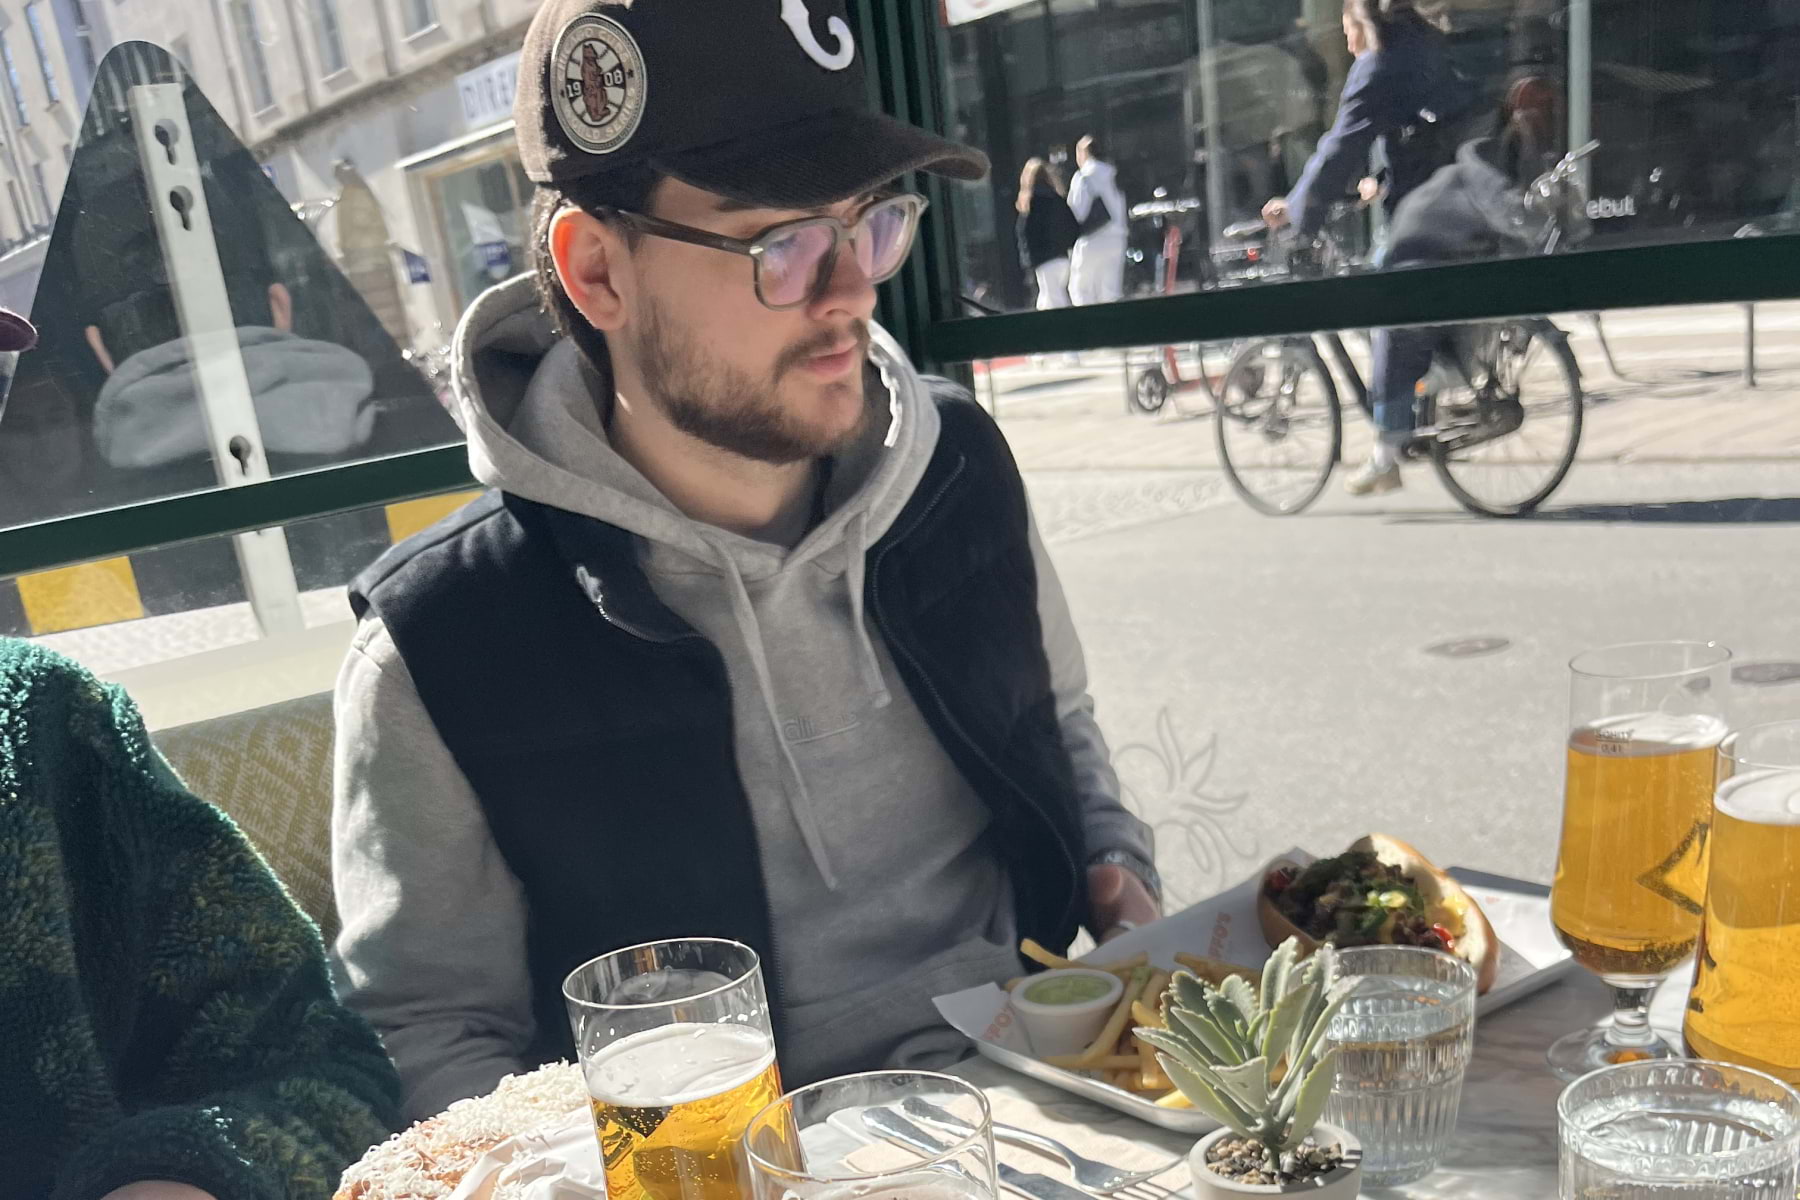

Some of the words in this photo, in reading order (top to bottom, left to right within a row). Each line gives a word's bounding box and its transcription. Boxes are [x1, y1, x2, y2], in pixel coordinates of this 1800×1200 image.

[461, 65, 518, 119] DIRE
[566, 81, 582, 98] 19
[603, 69, 624, 87] 08
